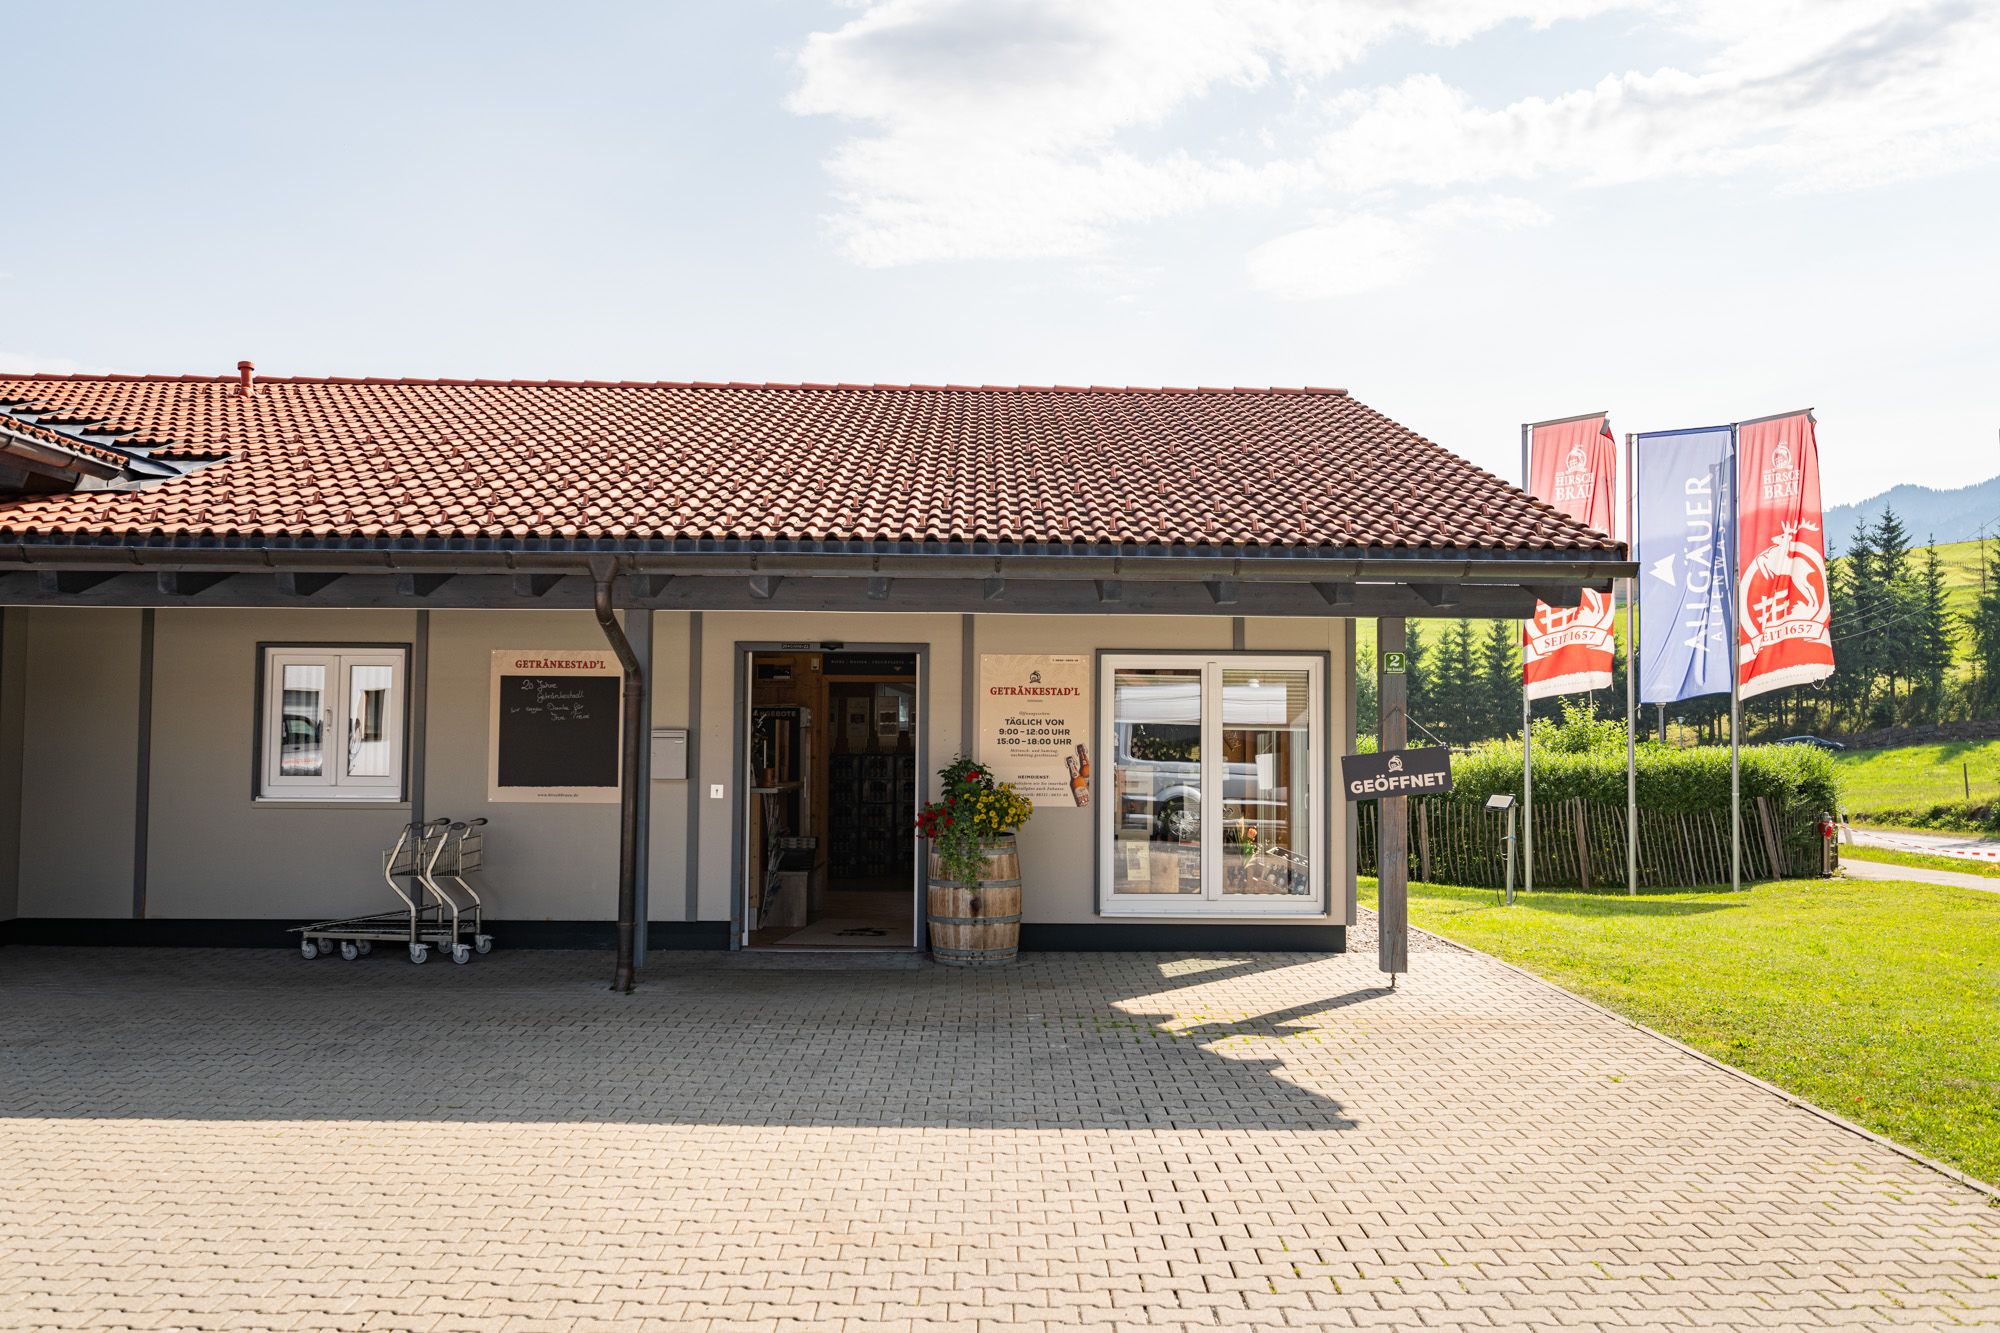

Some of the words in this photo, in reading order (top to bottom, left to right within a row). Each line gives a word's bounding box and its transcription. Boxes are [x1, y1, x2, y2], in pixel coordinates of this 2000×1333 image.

[1555, 472, 1594, 486] HIRSCH
[1555, 483, 1594, 501] BRÄU
[1544, 634, 1568, 649] SEIT
[1569, 630, 1597, 640] 1657
[1760, 628, 1782, 642] EIT
[1785, 624, 1813, 635] 1657
[1389, 654, 1400, 667] 2
[1005, 717, 1042, 726] TÄGLICH
[998, 728, 1019, 736] 9:00
[1026, 728, 1050, 736] 12:00
[1350, 772, 1446, 794] GEÖFFNET
